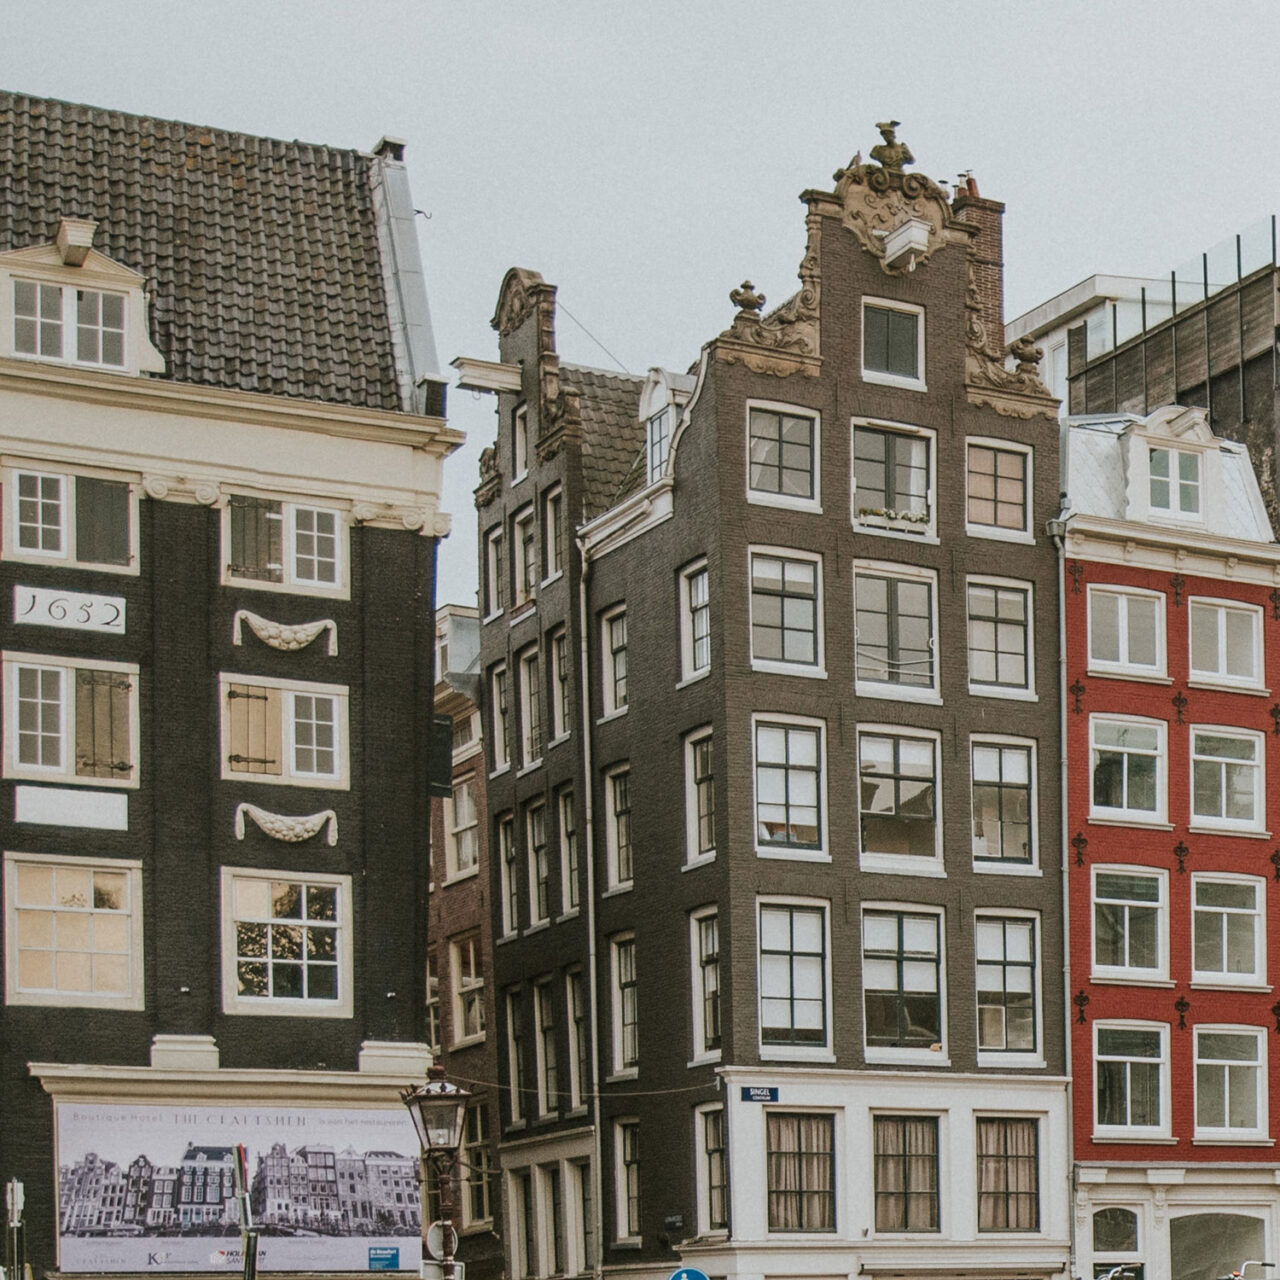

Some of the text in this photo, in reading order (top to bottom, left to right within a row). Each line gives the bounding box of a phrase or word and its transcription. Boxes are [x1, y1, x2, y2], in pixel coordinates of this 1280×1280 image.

[20, 594, 121, 627] 1652
[72, 1112, 126, 1123] Boutique
[130, 1112, 162, 1122] Hotel
